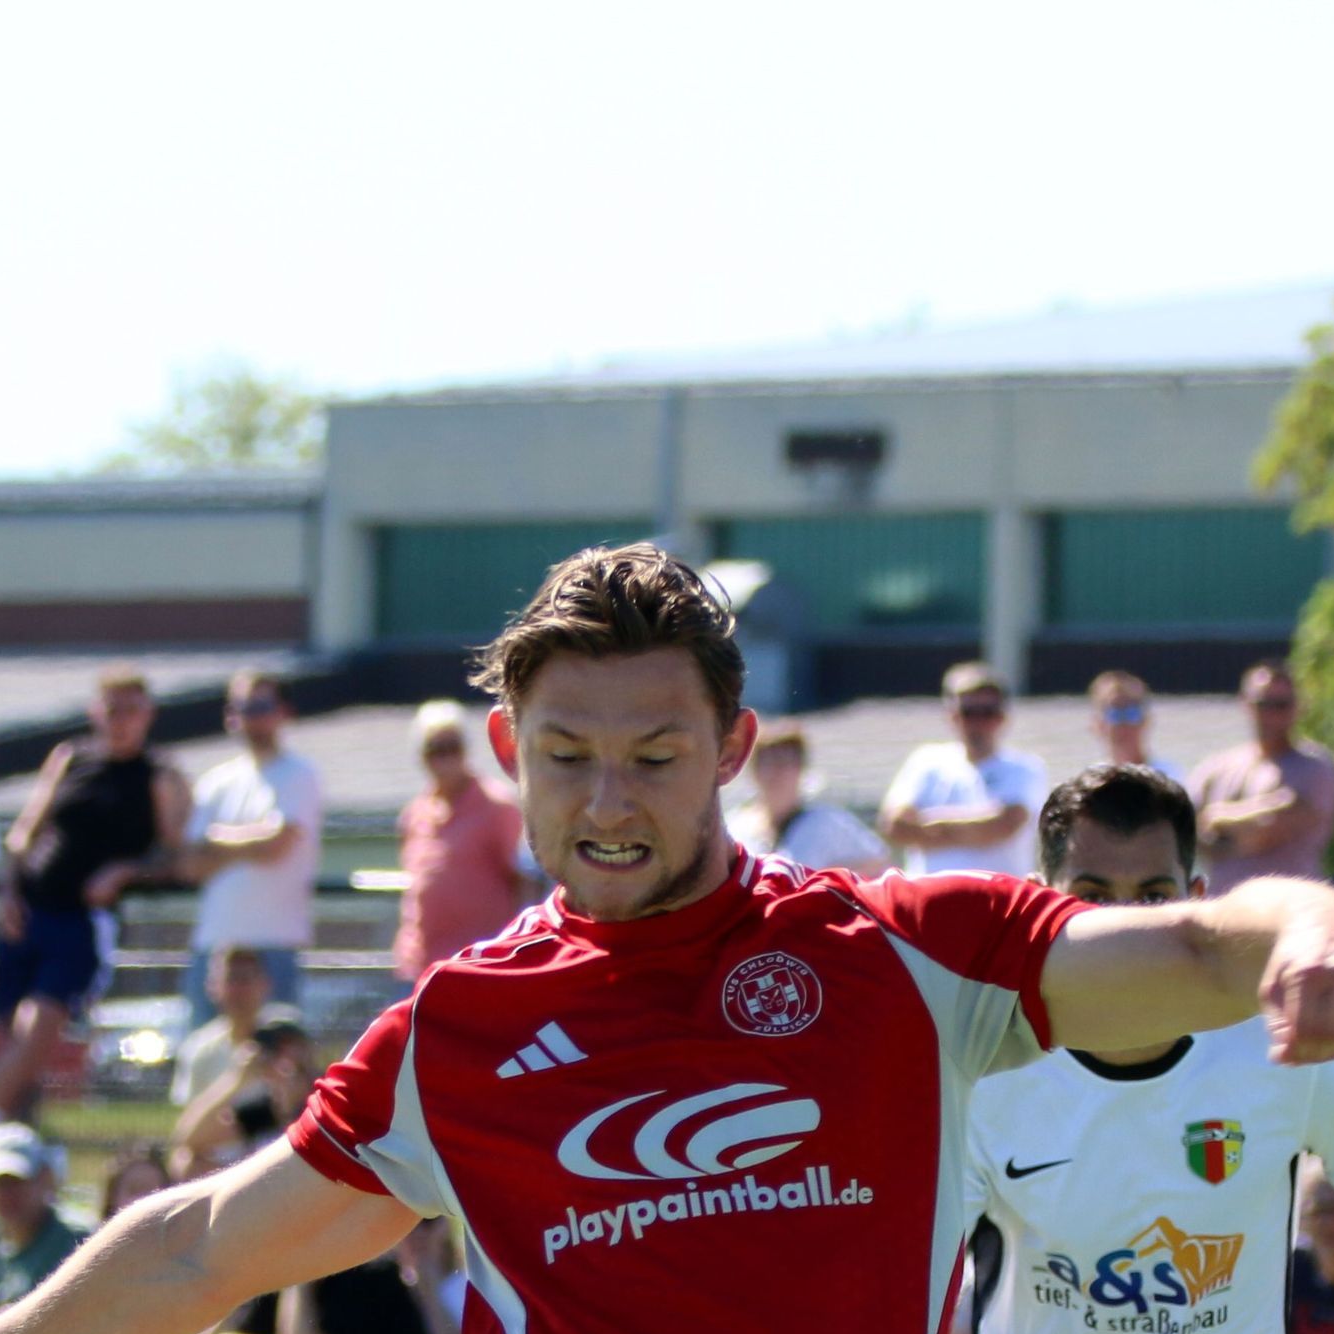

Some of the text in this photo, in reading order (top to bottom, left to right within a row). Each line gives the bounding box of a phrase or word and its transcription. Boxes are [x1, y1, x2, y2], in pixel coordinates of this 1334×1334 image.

[543, 1165, 874, 1265] playpaintball.de
[1045, 1248, 1189, 1314] a&s
[1083, 1305, 1098, 1331] &
